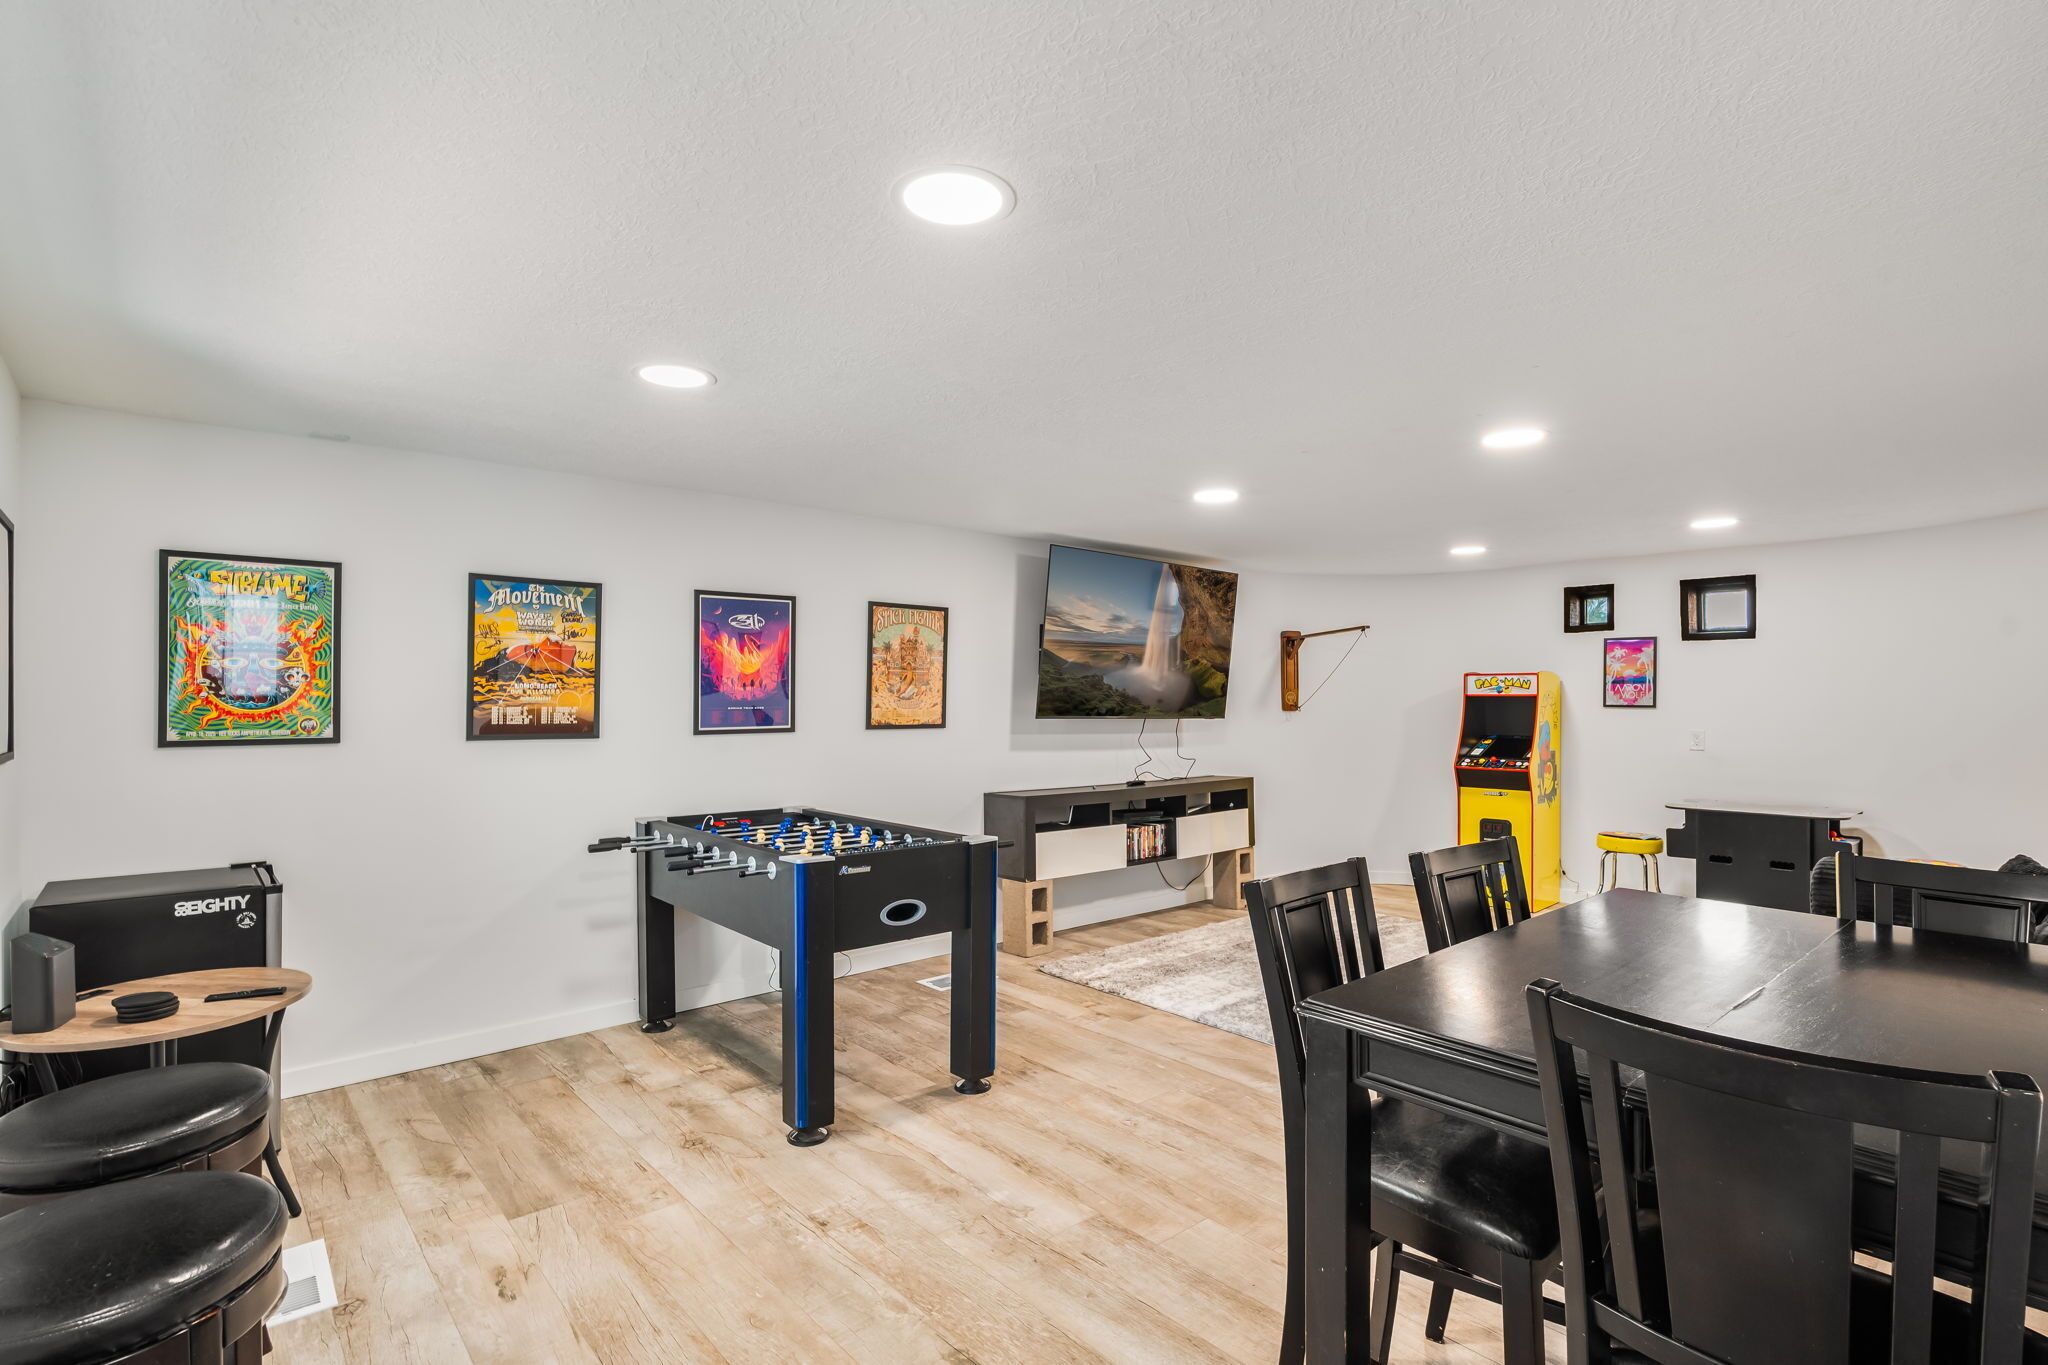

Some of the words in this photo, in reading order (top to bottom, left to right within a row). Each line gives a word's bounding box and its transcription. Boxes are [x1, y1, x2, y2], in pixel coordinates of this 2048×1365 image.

[484, 588, 585, 617] Movement
[518, 618, 554, 627] WORLD
[877, 608, 906, 632] STICK
